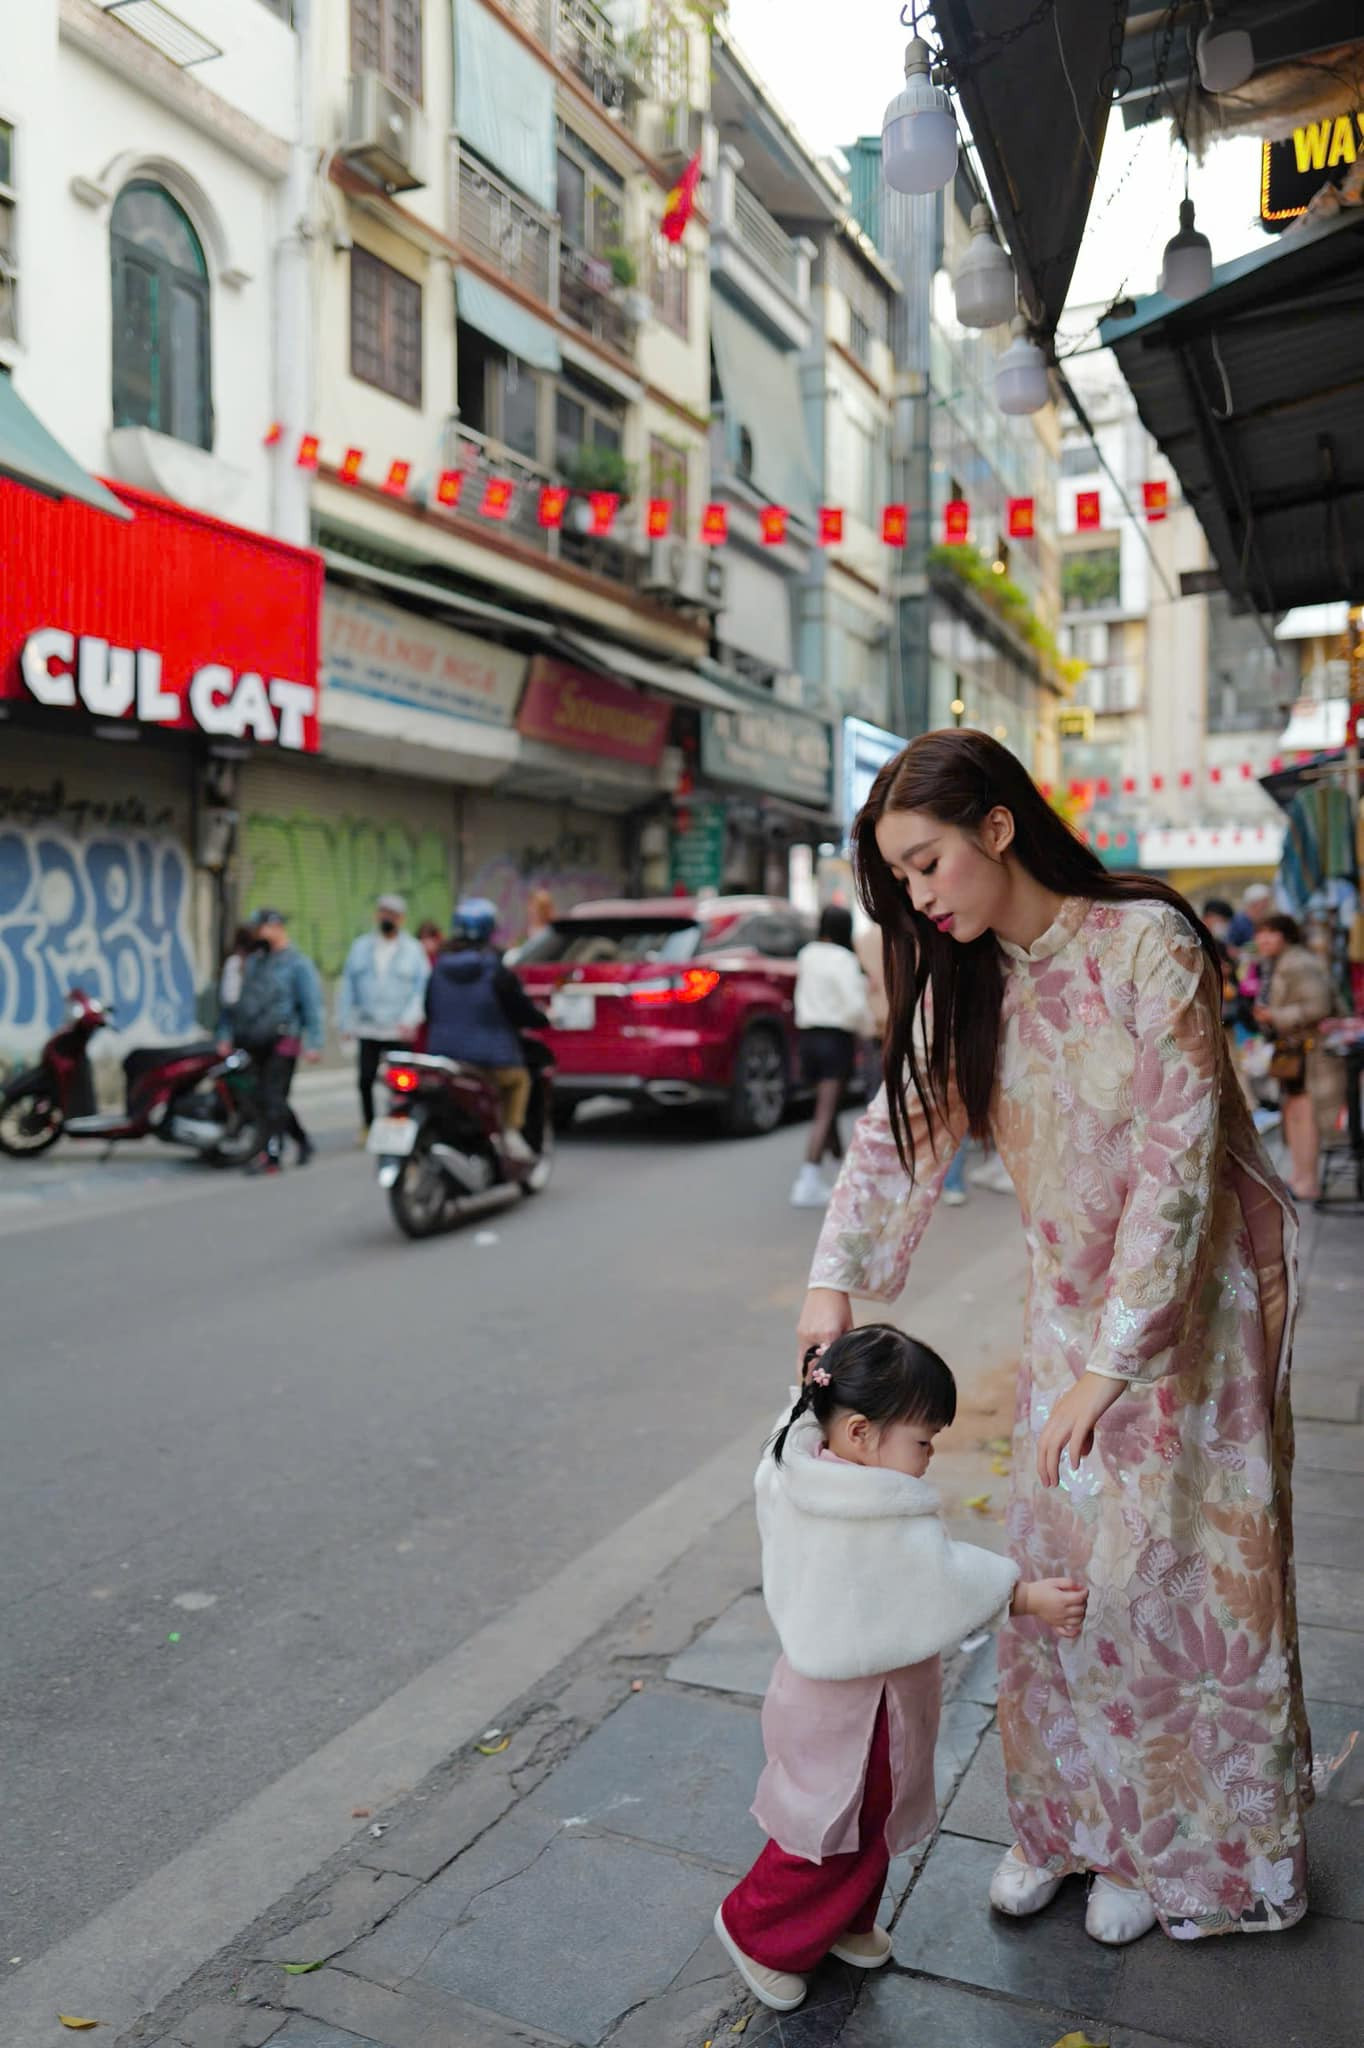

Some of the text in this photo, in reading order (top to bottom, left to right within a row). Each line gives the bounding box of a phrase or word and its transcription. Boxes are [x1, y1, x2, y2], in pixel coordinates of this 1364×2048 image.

[1294, 113, 1364, 173] WA
[21, 627, 180, 722] CUL
[189, 663, 314, 751] CAT
